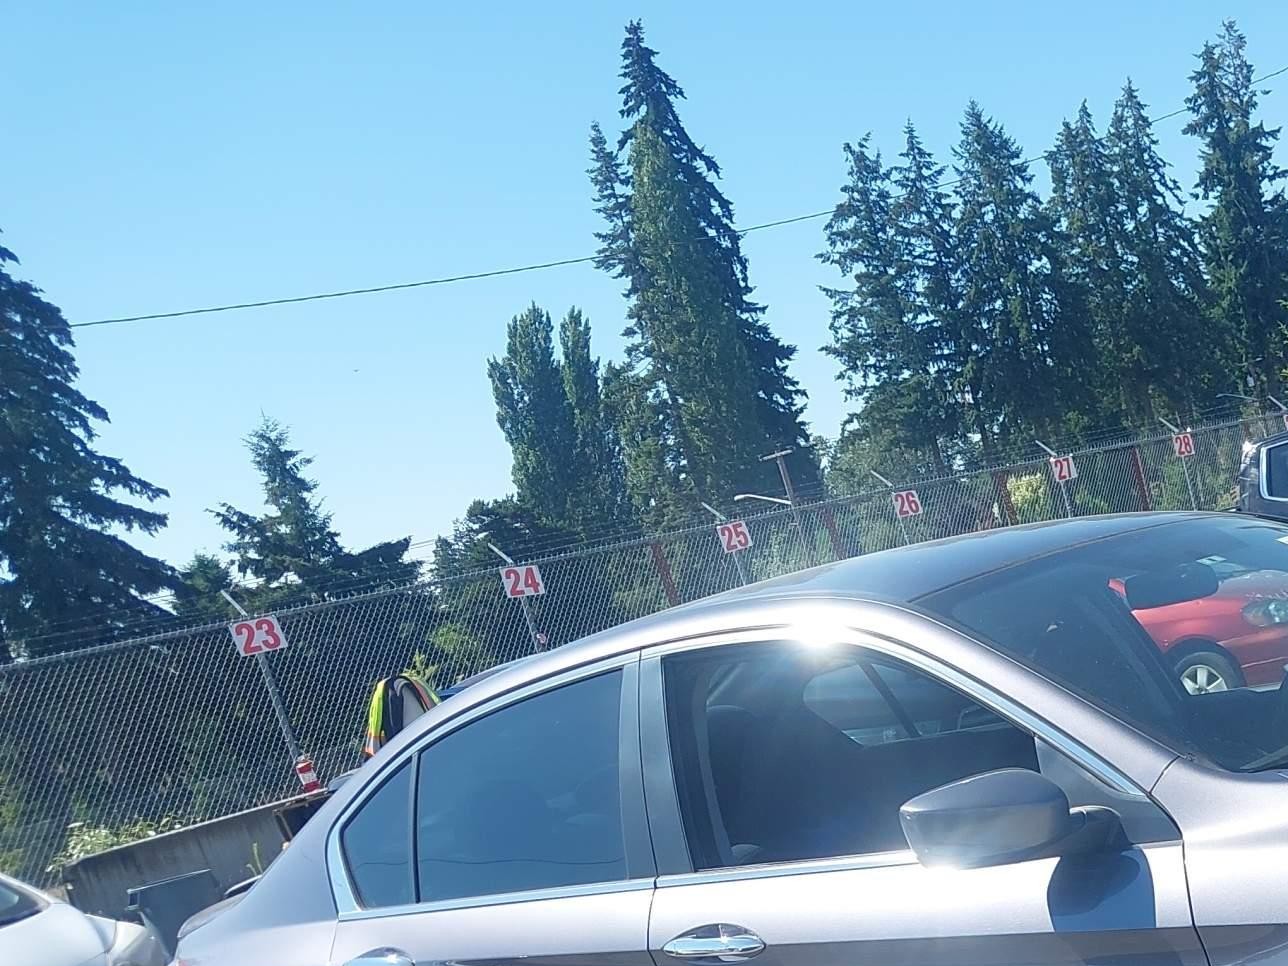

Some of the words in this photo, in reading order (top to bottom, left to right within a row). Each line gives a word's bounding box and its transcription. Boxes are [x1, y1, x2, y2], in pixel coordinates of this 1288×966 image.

[1175, 435, 1193, 455] 28
[1055, 457, 1072, 480] 27
[894, 491, 920, 515] 26
[720, 522, 749, 551] 25
[505, 567, 540, 596] 24
[235, 619, 281, 654] 23
